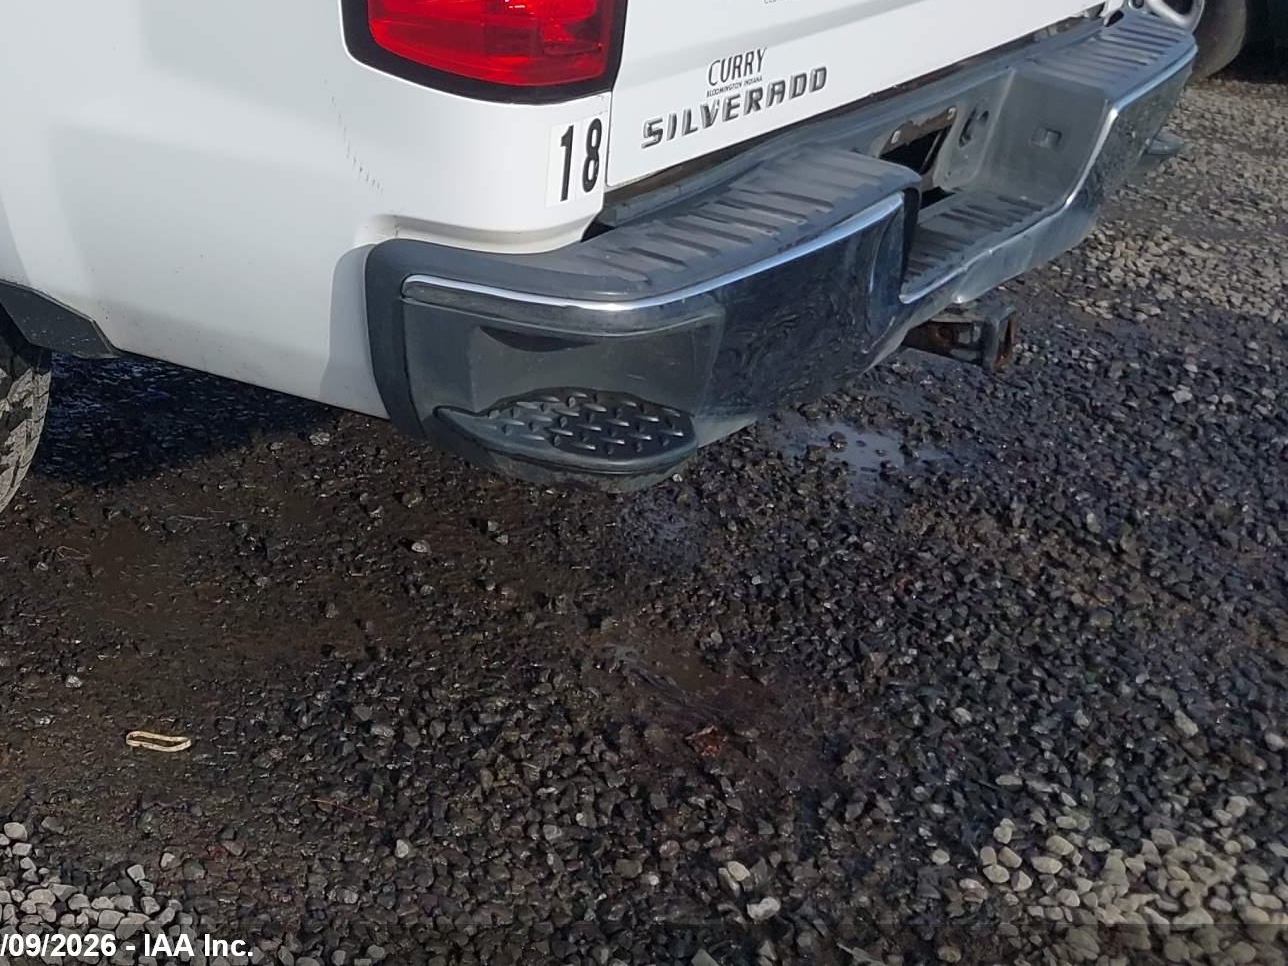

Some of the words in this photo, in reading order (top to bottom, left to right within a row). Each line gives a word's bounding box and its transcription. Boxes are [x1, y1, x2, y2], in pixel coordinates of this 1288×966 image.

[706, 82, 743, 98] BLOOMINGTON
[743, 75, 763, 87] INDIANA
[708, 46, 767, 87] CURRY
[641, 65, 828, 149] SILVERADO
[559, 117, 603, 203] 18
